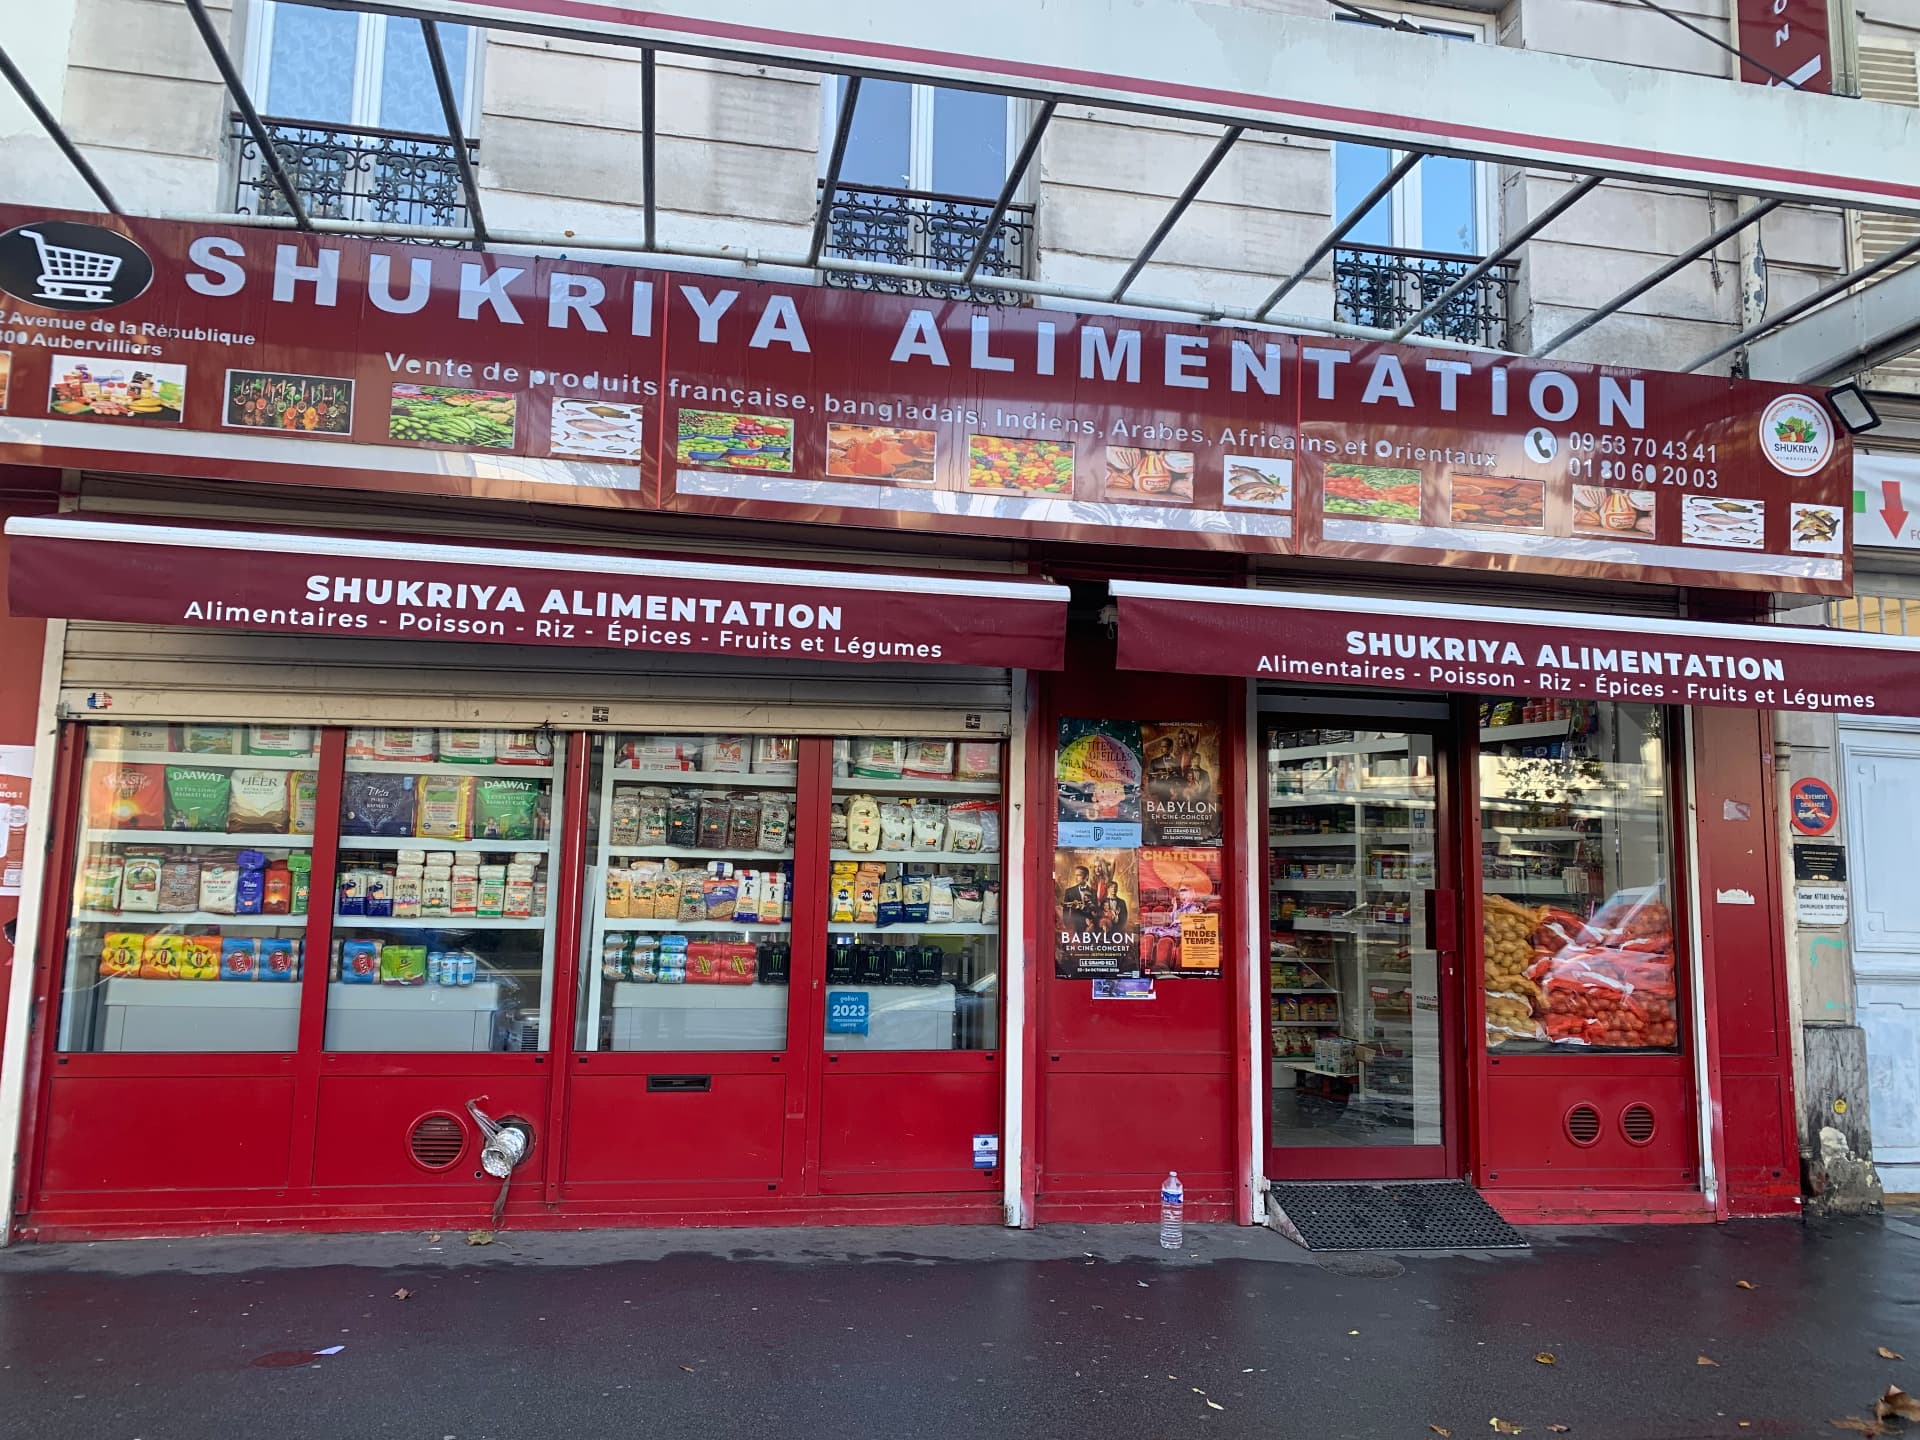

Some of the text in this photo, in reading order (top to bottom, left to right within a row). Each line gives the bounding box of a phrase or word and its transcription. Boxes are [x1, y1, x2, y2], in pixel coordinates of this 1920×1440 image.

[8, 311, 87, 331] Avenue
[90, 318, 116, 333] de
[120, 321, 137, 335] la
[141, 323, 256, 346] République
[185, 236, 1646, 429] SHUKRIYA ALIMENTATION
[32, 332, 163, 356] Aubervilliers
[385, 351, 473, 379] Vente
[483, 362, 519, 382] de
[529, 368, 658, 396] produits
[668, 378, 815, 413] française,
[996, 409, 1104, 438] Indiens,
[1112, 418, 1212, 446] Arabes,
[1219, 427, 1338, 453] Africains
[1345, 440, 1367, 456] et
[1375, 439, 1497, 467] Orientaux
[1569, 432, 1717, 464] 09 53 70 43 41
[1774, 443, 1819, 455] SHUKRIYA
[1569, 457, 1593, 478] 01
[1632, 463, 1657, 484] 60
[1662, 466, 1688, 486] 20
[1693, 468, 1718, 489] 03
[306, 574, 842, 630] SHUKRIYA ALIMENTATION
[184, 601, 368, 628] Alimentaires
[399, 612, 504, 635] Poisson
[536, 619, 575, 639] Riz
[607, 621, 691, 646] Épices
[720, 630, 792, 650] Fruits
[800, 638, 824, 653] et
[834, 636, 942, 659] Légumes
[1346, 630, 1785, 681] SHUKRIYA ALIMENTATION
[1257, 655, 1405, 681] Alimentaires
[1430, 666, 1514, 687] Poisson
[1539, 673, 1571, 691] Riz
[1596, 674, 1664, 697] Épices
[1688, 683, 1747, 702] Fruits
[1754, 688, 1775, 704] et
[1783, 688, 1875, 709] Légumes
[173, 770, 225, 783] DAAWAT
[241, 776, 278, 787] HEER
[484, 780, 532, 791] DAAWAT
[1147, 801, 1217, 813] BABYLON
[1061, 931, 1135, 944] BABYLON
[1183, 930, 1216, 938] FIN DES
[832, 1004, 866, 1017] 2023
